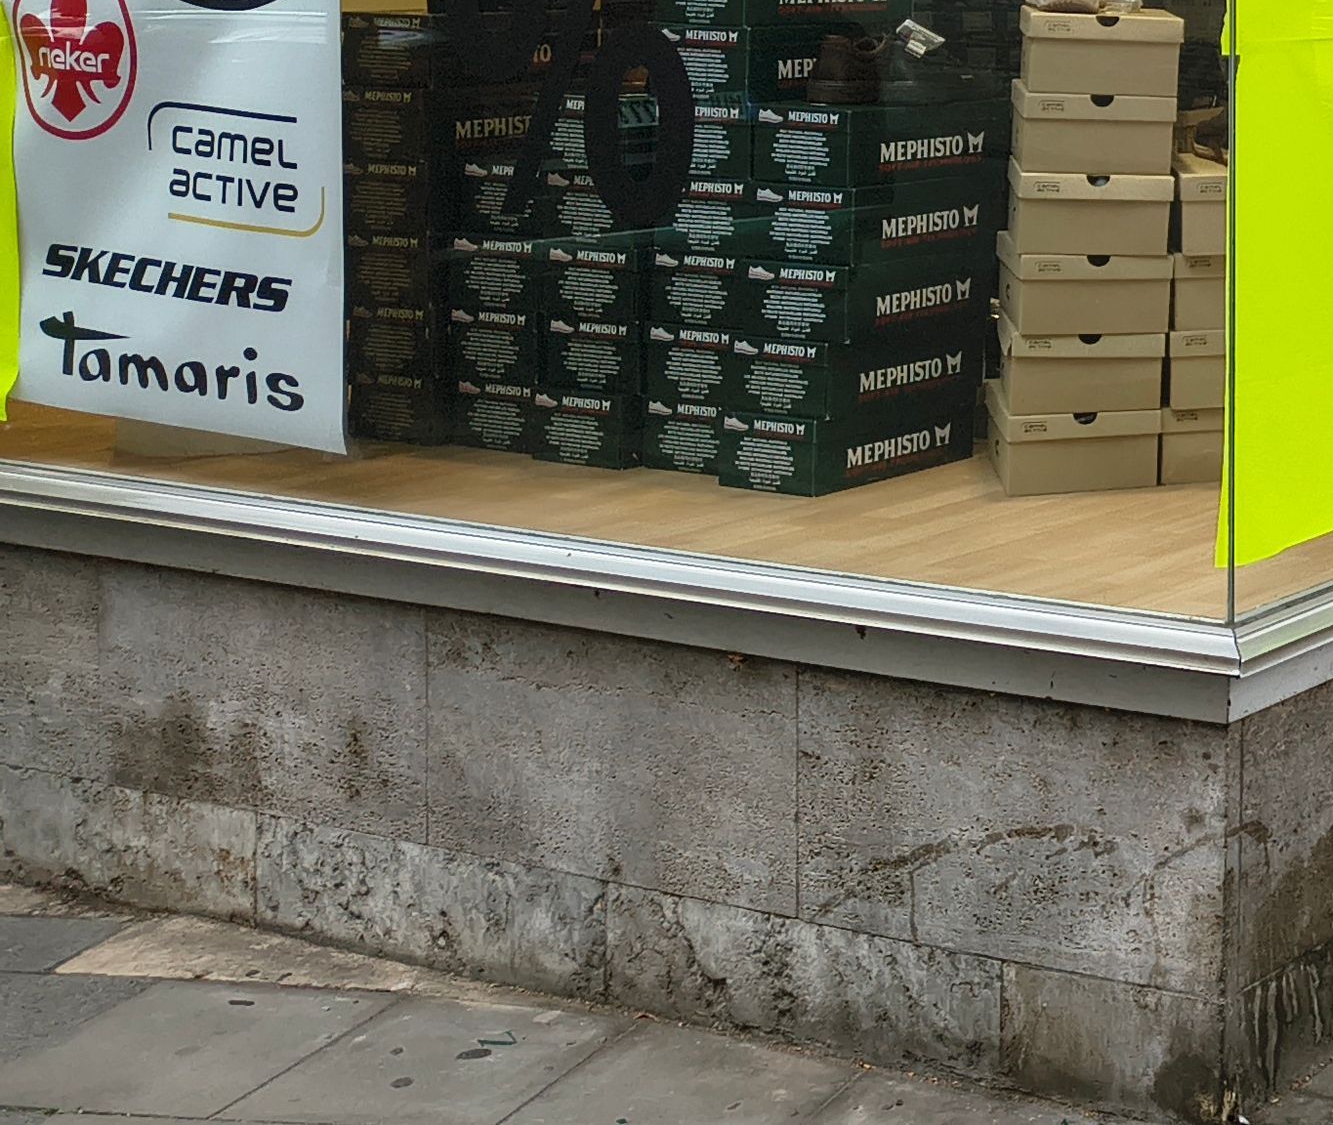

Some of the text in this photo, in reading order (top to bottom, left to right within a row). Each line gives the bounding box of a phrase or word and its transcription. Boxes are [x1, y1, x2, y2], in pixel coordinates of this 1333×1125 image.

[685, 29, 727, 42] MEPHISTO
[788, 111, 828, 124] MEPHISTO
[455, 115, 532, 140] MEPHIST
[880, 134, 963, 163] MEPHISTO
[690, 181, 733, 195] MEPHISTO
[788, 190, 831, 203] MEPHISTO
[882, 209, 960, 240] MEPHISTO
[683, 255, 724, 269] MEPHISTO
[42, 243, 292, 312] SKECHERS
[779, 268, 823, 281] MEPHISTO
[876, 283, 952, 317] MEPHISTO
[679, 329, 720, 344] MEPHISTO
[763, 342, 805, 357] MEPHISTO
[859, 357, 942, 394] MEPHISTO
[677, 403, 717, 417] MEPHISTO
[753, 419, 794, 434] MEPHISTO
[846, 430, 931, 469] MEPHISTO
